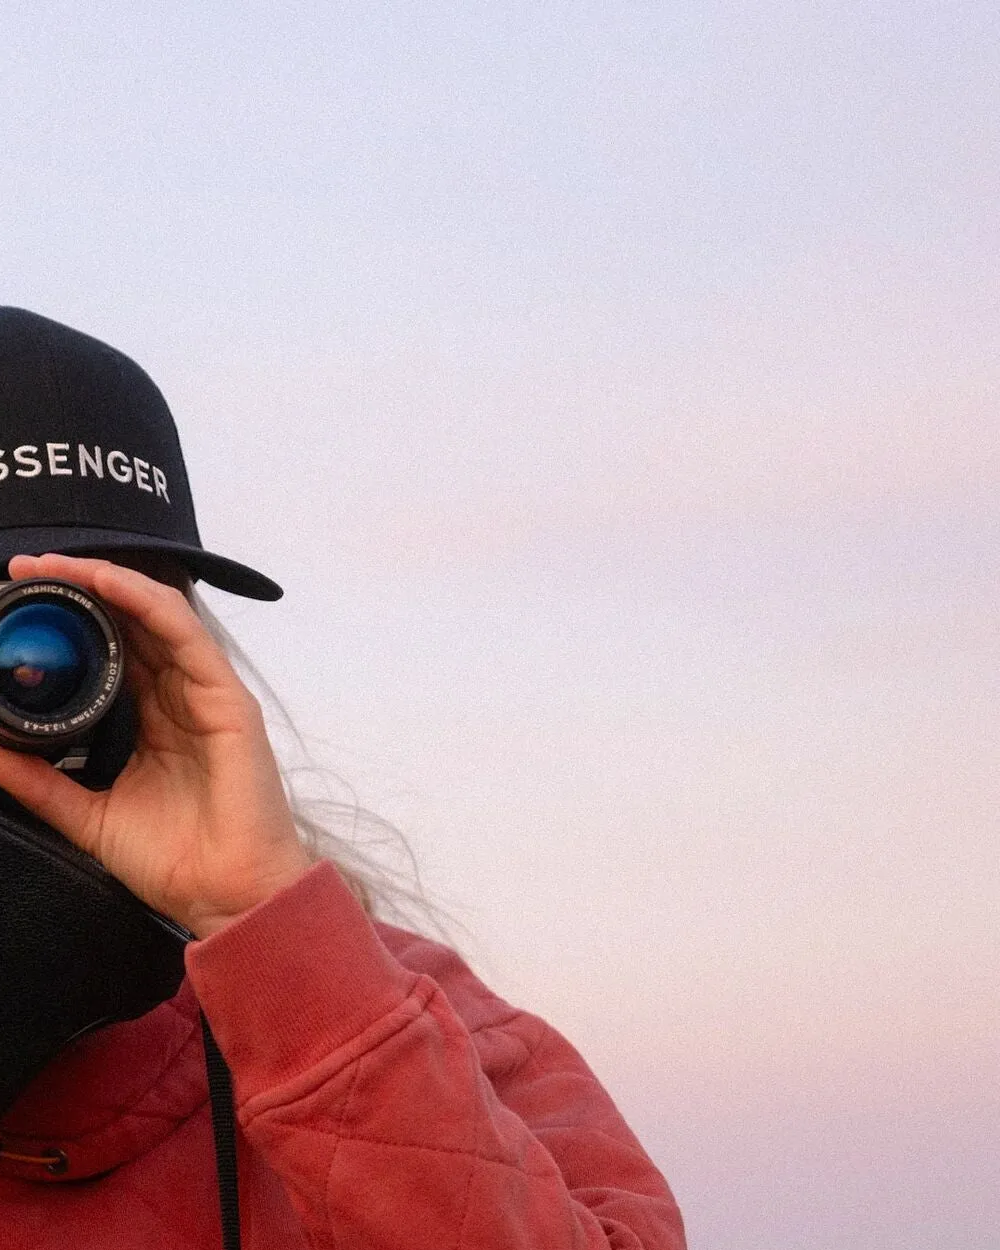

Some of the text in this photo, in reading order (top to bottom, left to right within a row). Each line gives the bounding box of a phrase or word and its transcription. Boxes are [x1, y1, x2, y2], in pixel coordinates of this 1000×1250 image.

[22, 585, 94, 609] YASHICA LENS
[107, 641, 117, 656] ML
[104, 662, 118, 691] ZOOM
